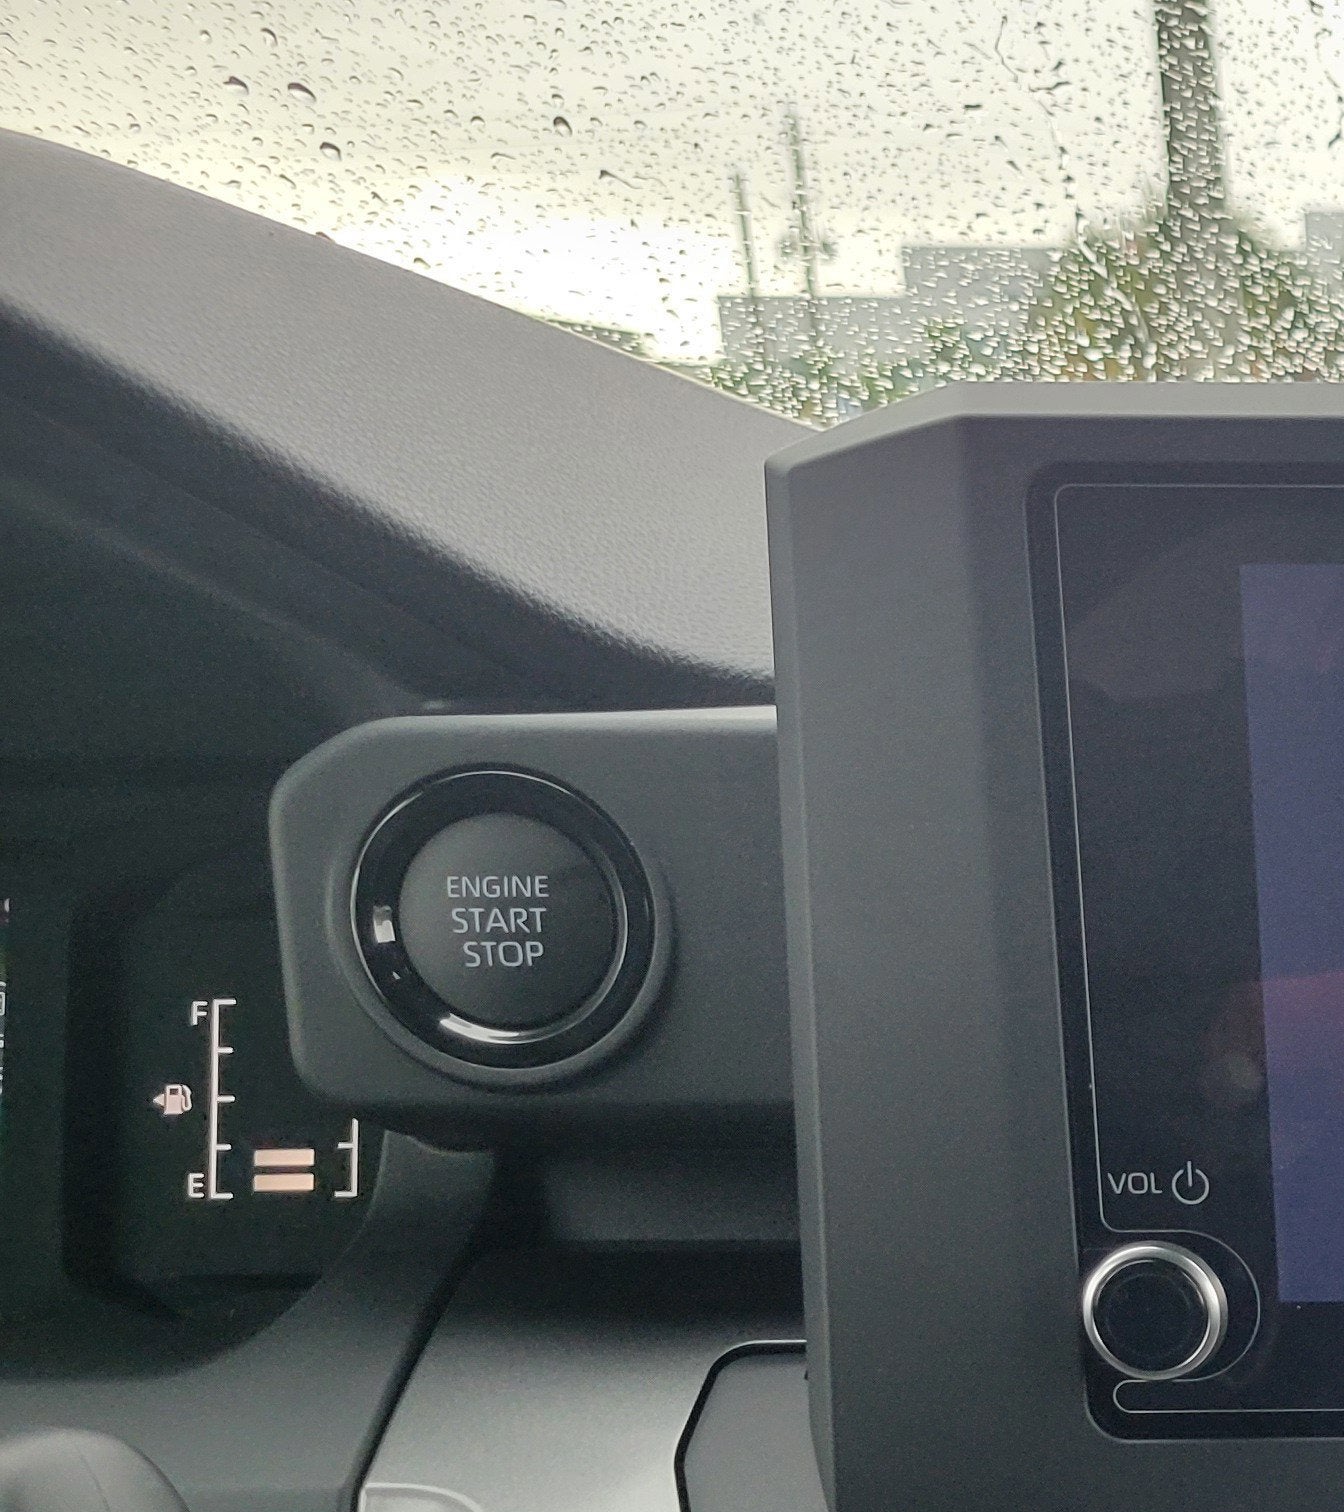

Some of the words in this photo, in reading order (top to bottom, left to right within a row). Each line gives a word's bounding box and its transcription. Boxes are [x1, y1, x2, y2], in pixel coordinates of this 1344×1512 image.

[447, 875, 549, 898] ENGINE
[451, 908, 547, 934] START
[463, 941, 544, 967] STOP
[190, 1001, 209, 1026] F
[187, 1172, 205, 1197] E
[1108, 1172, 1162, 1196] VOL
